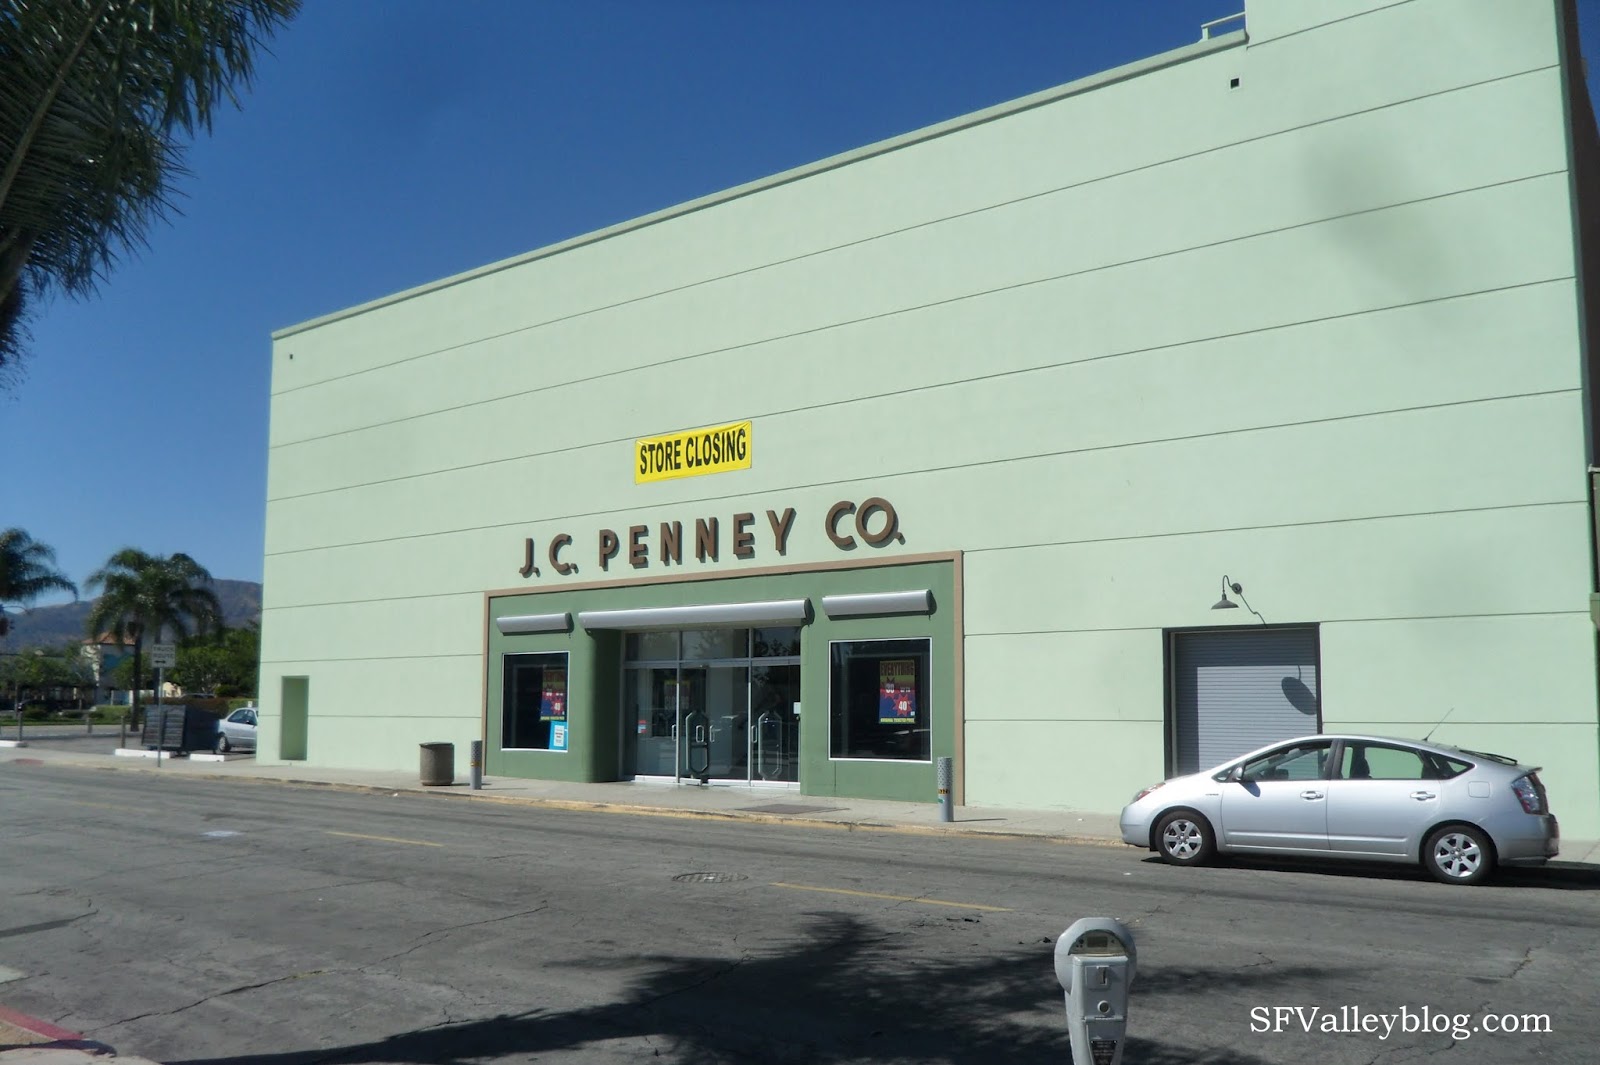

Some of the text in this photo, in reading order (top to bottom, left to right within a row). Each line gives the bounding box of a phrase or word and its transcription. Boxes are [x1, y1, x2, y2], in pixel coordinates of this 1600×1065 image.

[640, 428, 746, 474] STORE CLOSING
[599, 508, 795, 570] PENNEY
[825, 497, 905, 549] CO.
